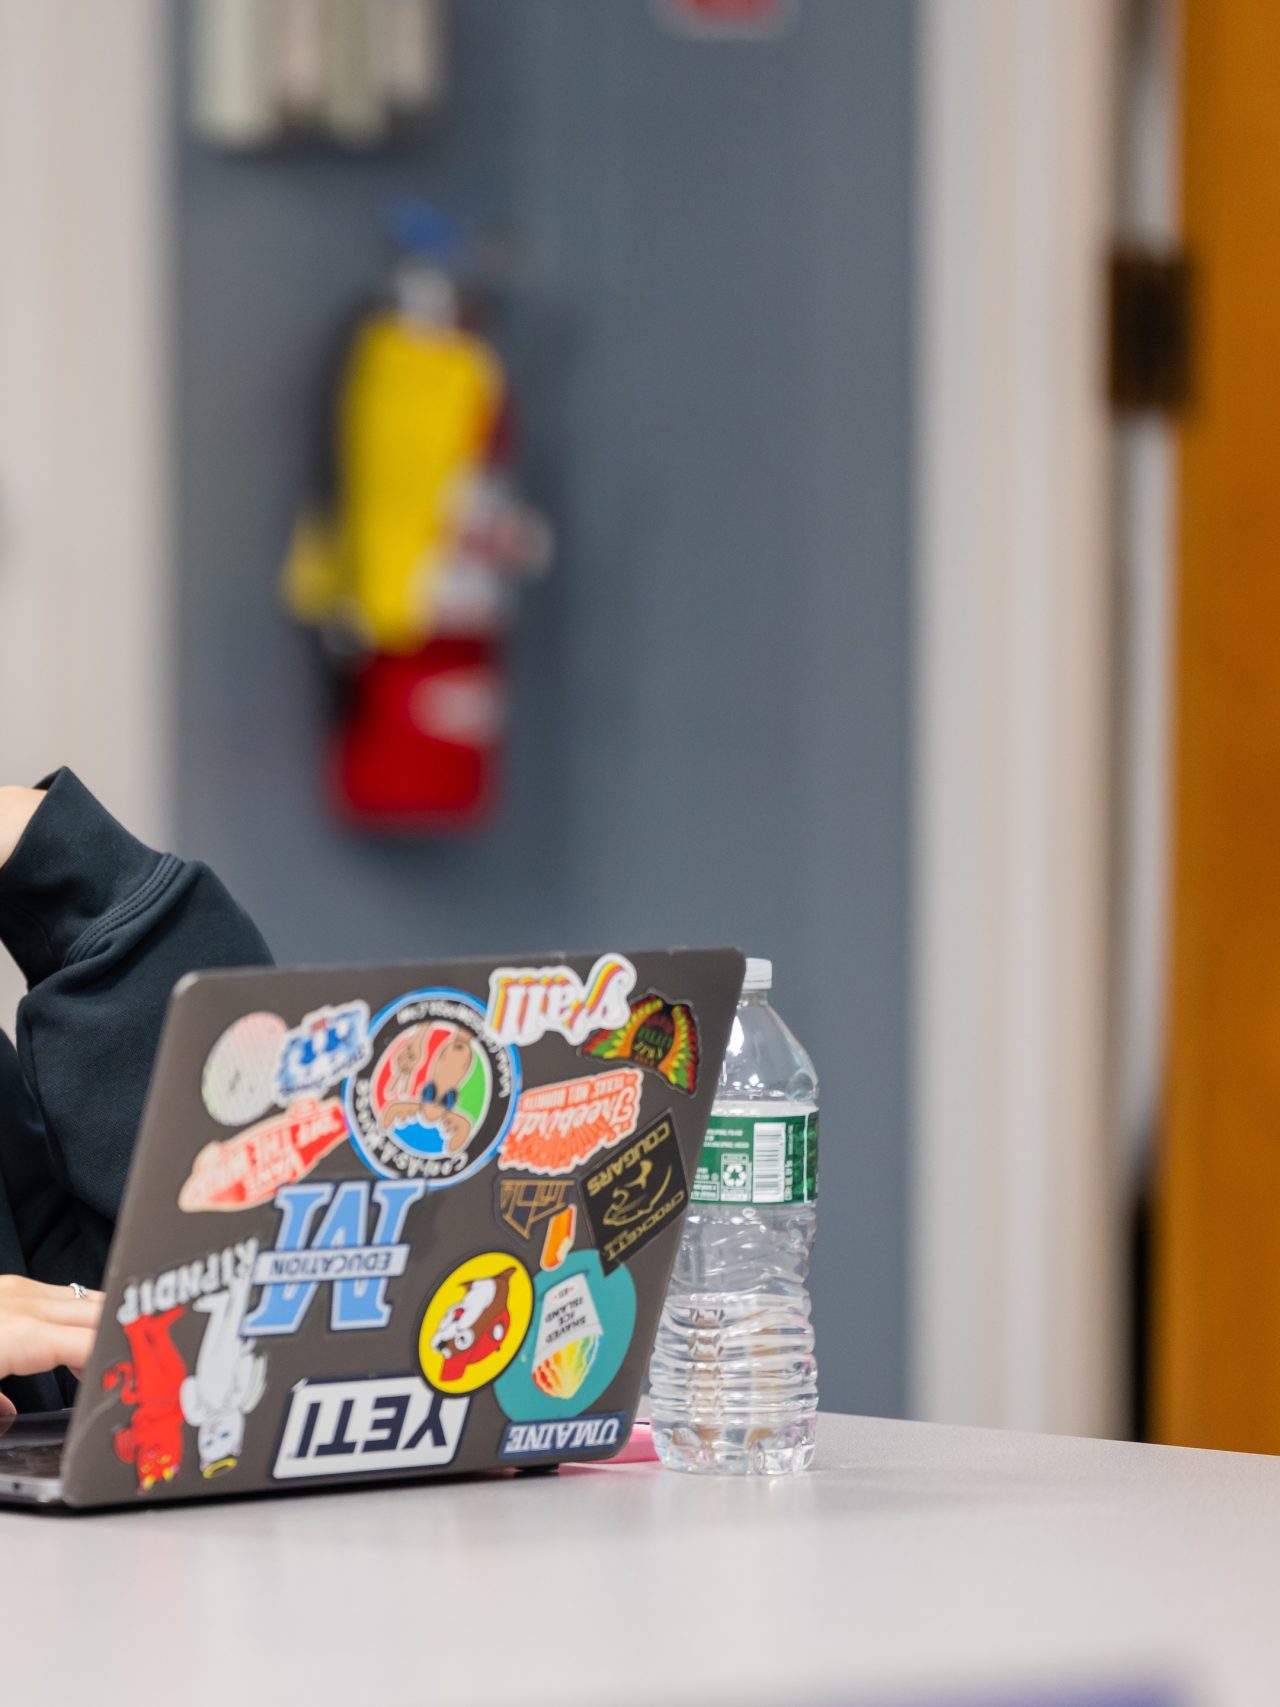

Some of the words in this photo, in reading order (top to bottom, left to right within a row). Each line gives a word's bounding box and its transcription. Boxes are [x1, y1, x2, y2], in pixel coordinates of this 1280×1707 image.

[491, 958, 631, 1038] y'all
[586, 1121, 670, 1197] COUGARS
[603, 1190, 685, 1261] CROCKETT
[116, 1237, 259, 1324] RIPNDIP
[272, 1250, 393, 1274] EDUCATION
[545, 1297, 583, 1323] ISLAND
[545, 1315, 586, 1343] SHAVED
[559, 1311, 575, 1325] ICE
[293, 1394, 448, 1459] YETI
[505, 1418, 620, 1453] UMAINE
